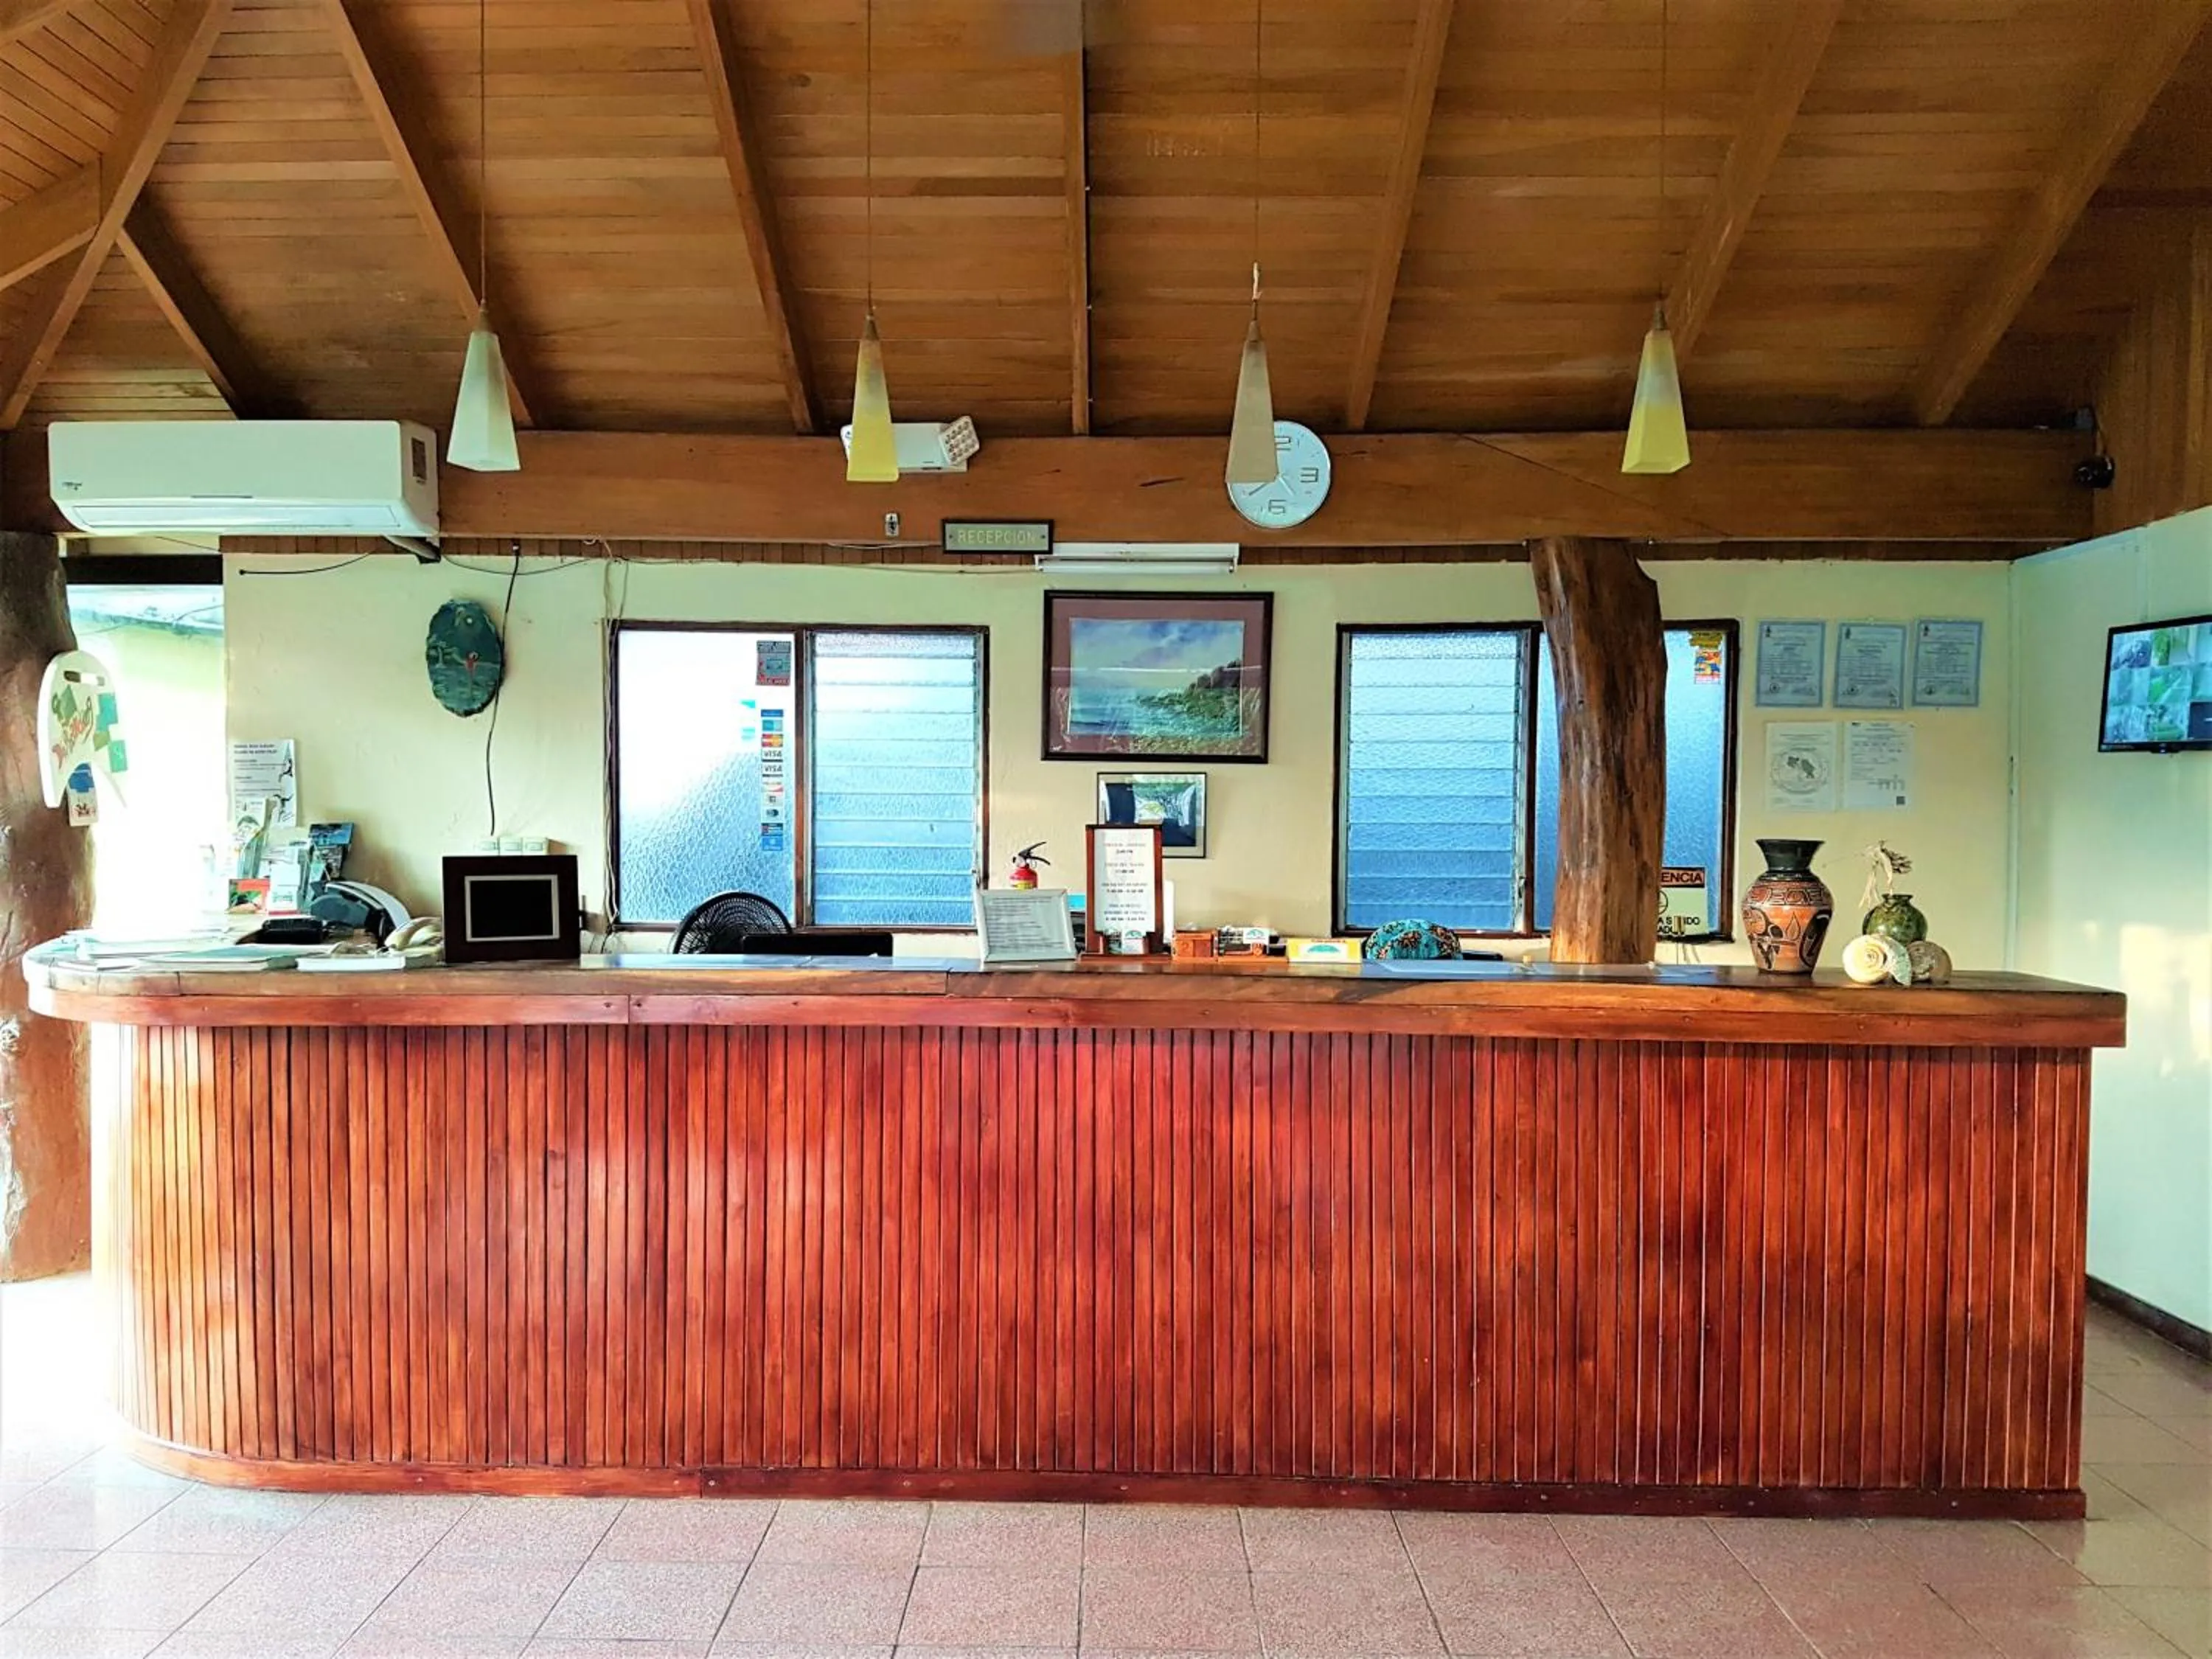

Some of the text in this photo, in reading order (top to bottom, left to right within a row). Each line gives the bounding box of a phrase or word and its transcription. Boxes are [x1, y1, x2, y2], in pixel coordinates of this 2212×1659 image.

[1300, 467, 1319, 483] 3
[1267, 499, 1287, 515] 6
[958, 529, 1036, 544] RECEPCION
